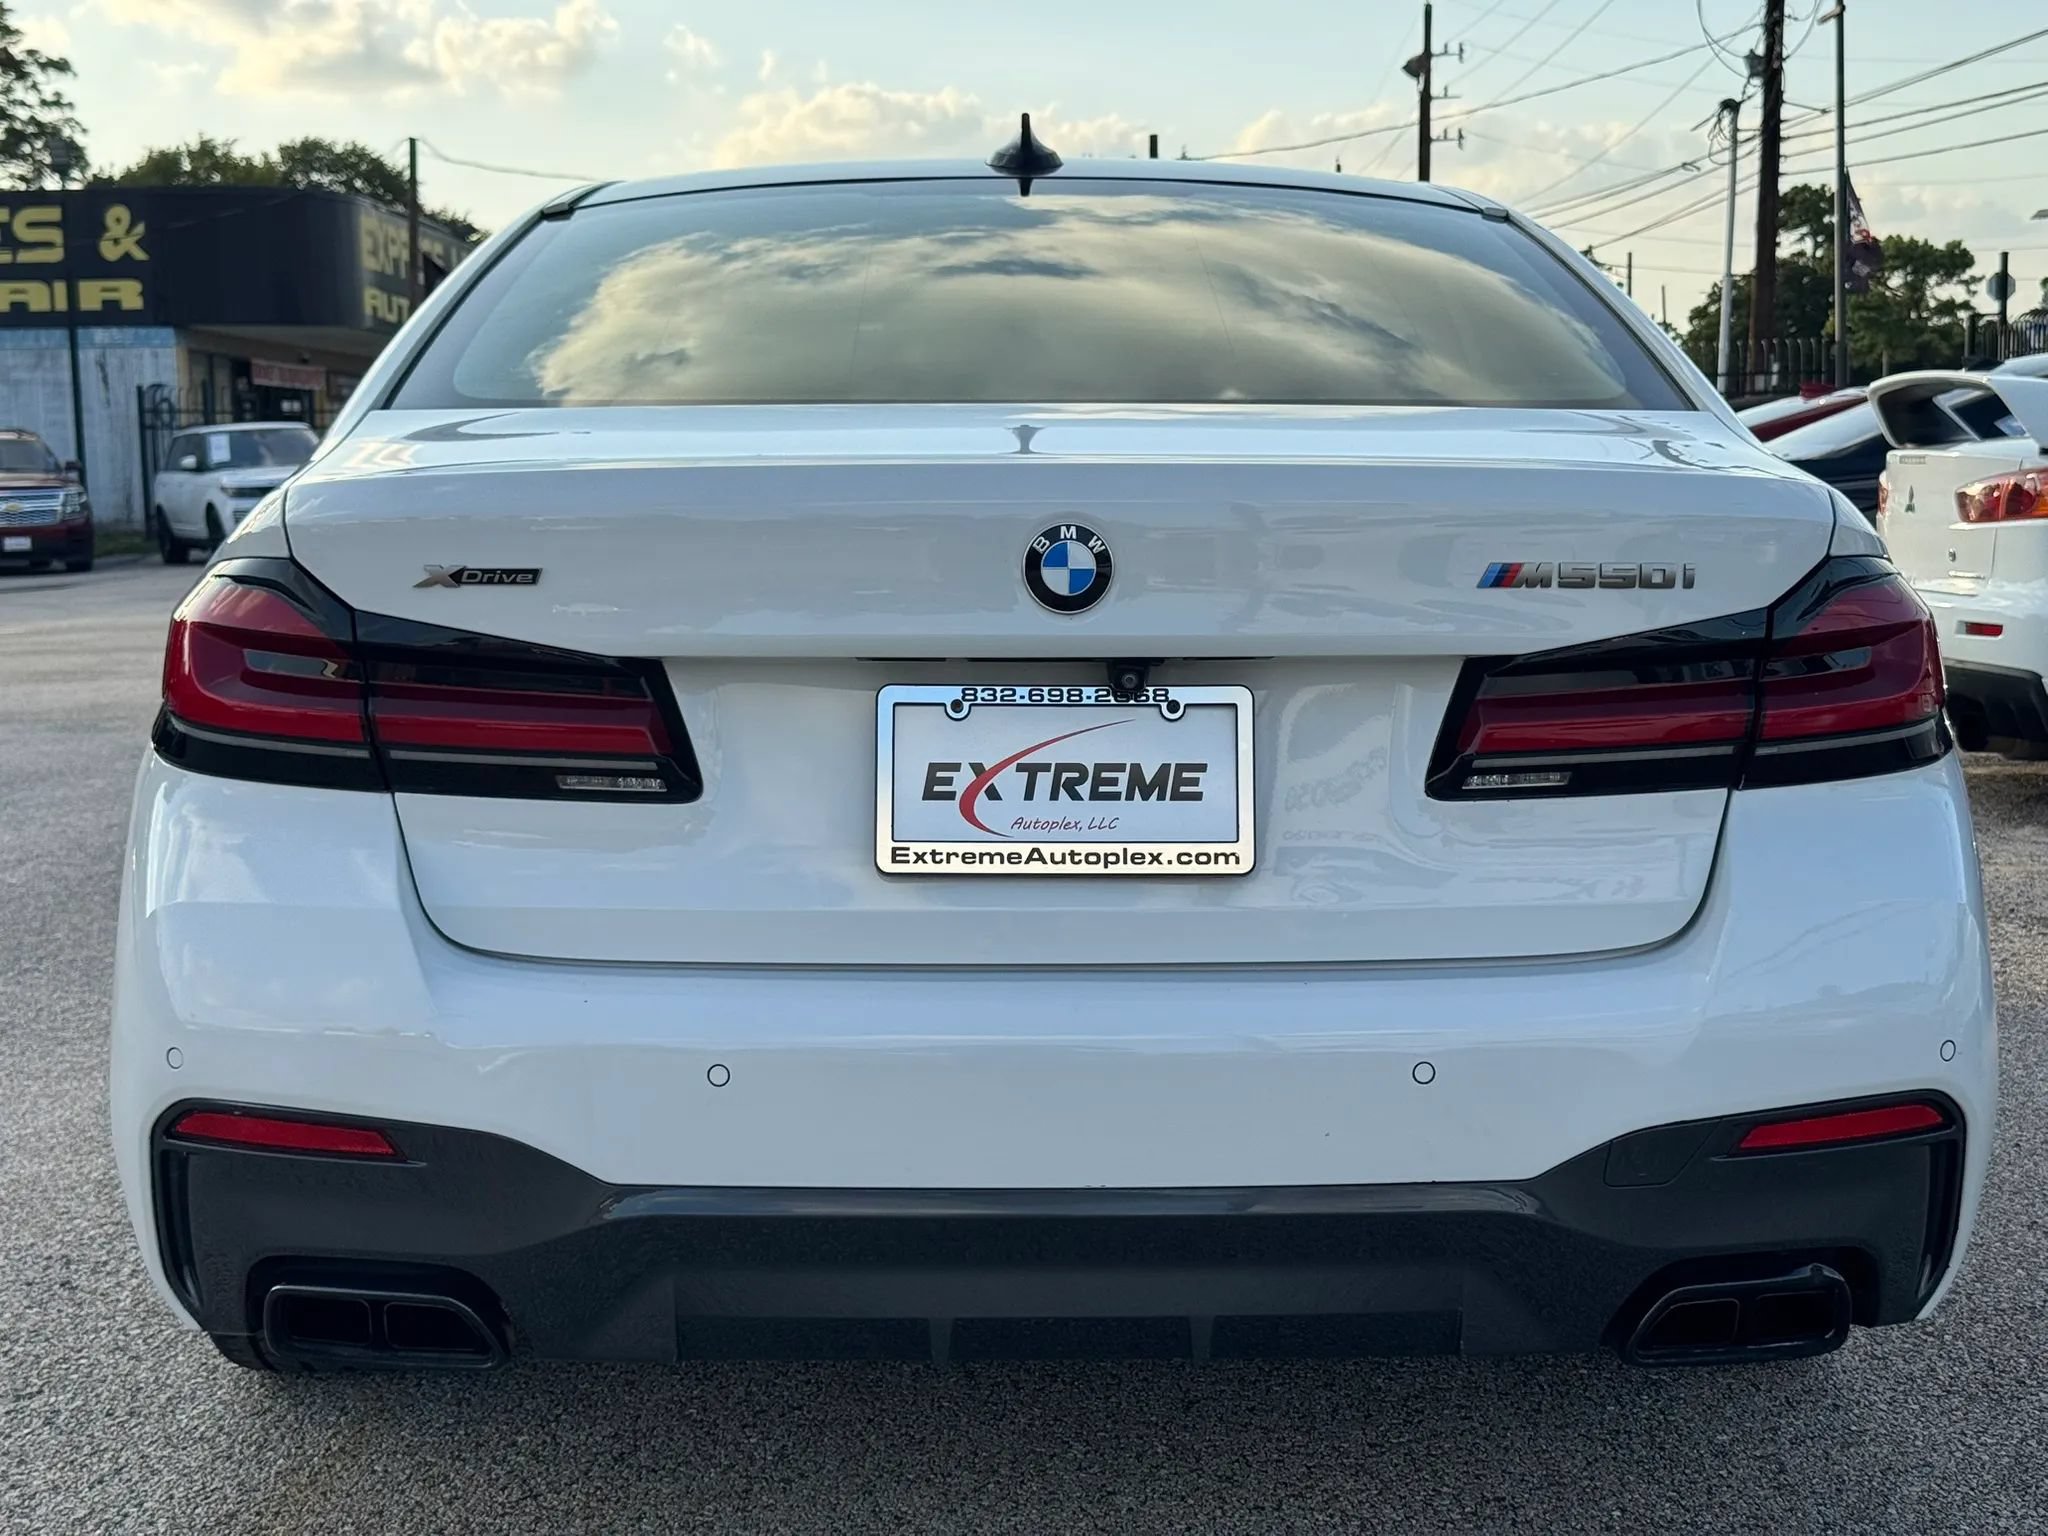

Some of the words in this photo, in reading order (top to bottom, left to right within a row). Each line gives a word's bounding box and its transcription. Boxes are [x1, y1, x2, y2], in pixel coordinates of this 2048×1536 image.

[99, 203, 150, 262] &
[1032, 525, 1106, 555] BMW
[1517, 562, 1697, 589] M550i
[921, 762, 1208, 801] EXTREME
[1010, 816, 1083, 834] Autoplex,
[1087, 816, 1120, 831] LLC
[890, 847, 1241, 867] ExtremeAutoplex.com
